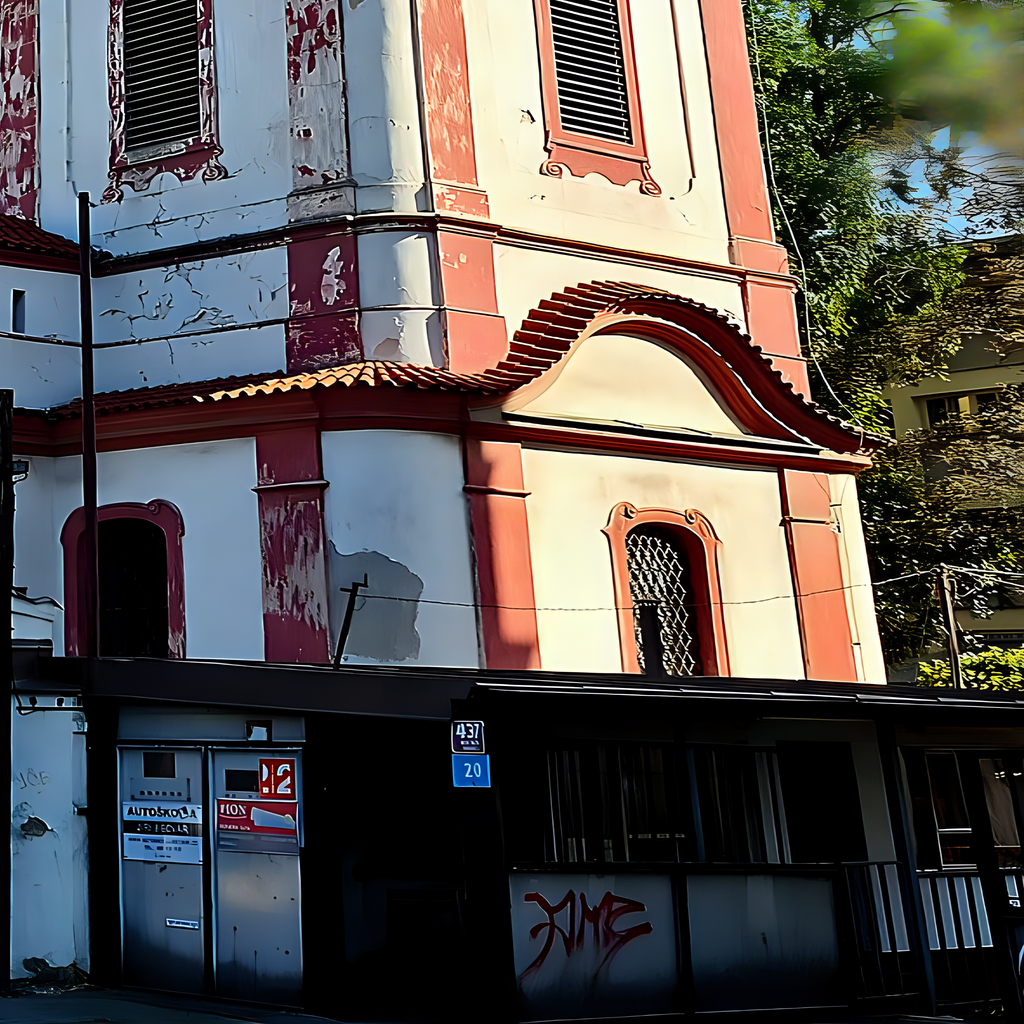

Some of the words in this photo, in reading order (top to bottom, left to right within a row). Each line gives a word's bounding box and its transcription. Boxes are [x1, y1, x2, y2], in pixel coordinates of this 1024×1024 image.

[456, 723, 480, 739] 437
[464, 762, 481, 778] 20
[127, 806, 198, 820] AUTOŠKOLA
